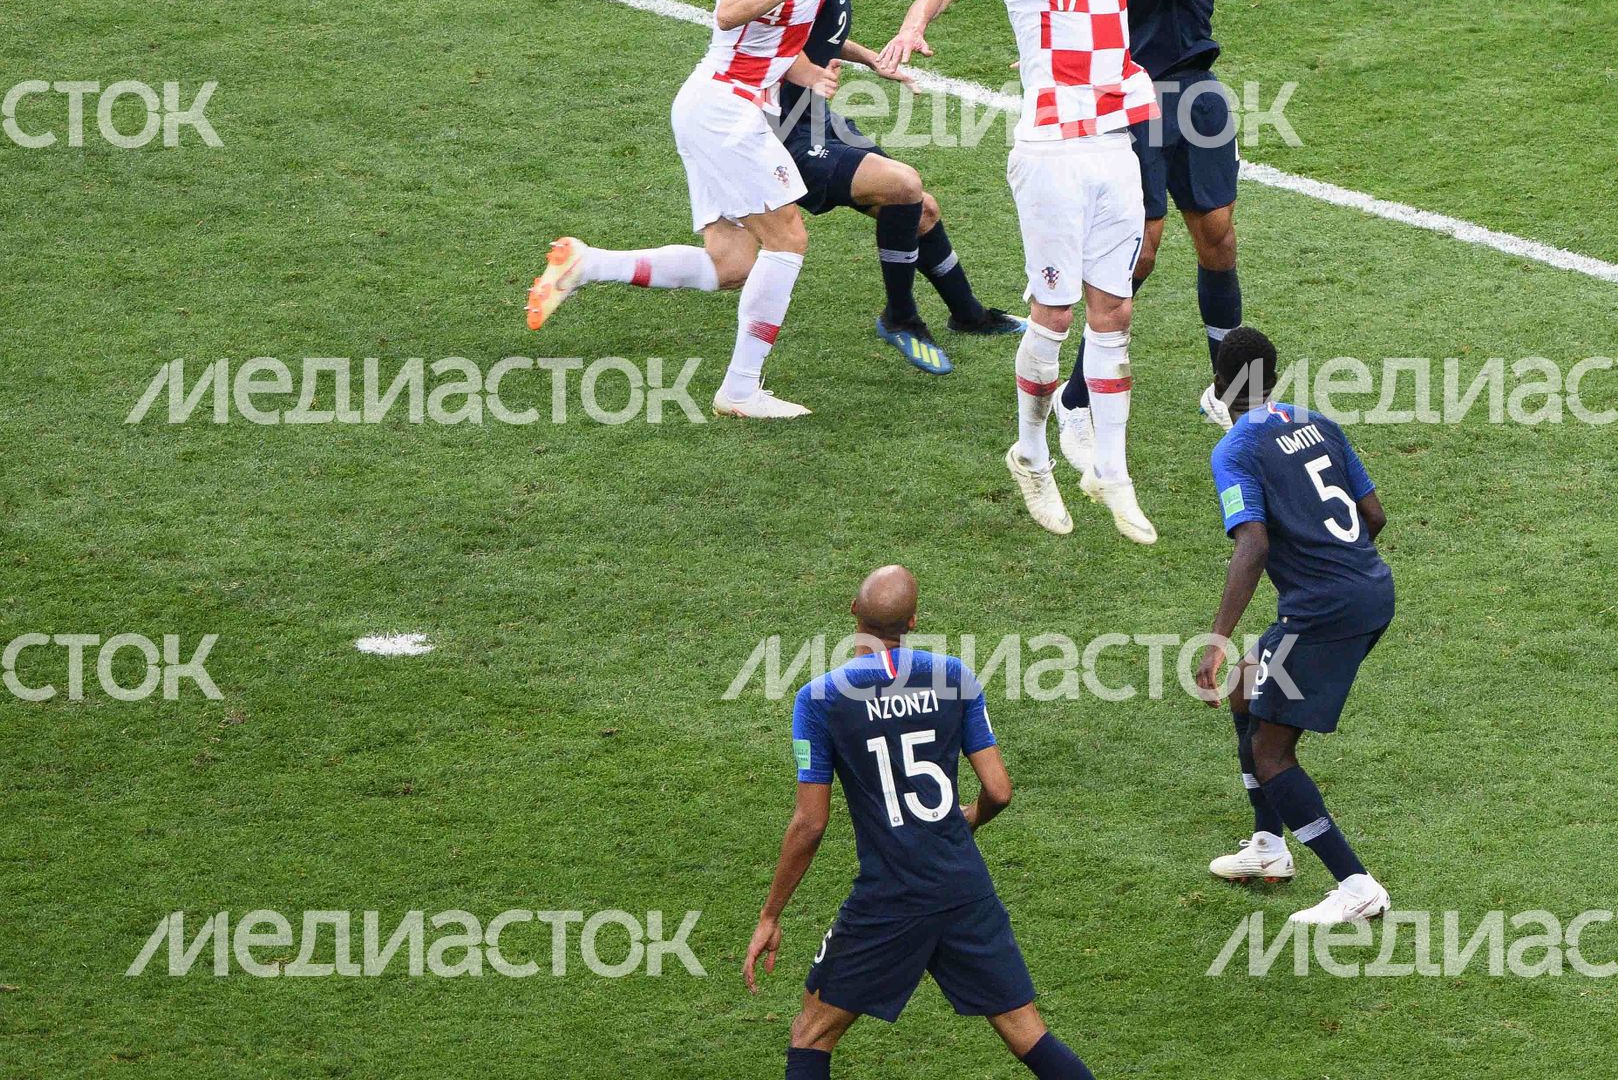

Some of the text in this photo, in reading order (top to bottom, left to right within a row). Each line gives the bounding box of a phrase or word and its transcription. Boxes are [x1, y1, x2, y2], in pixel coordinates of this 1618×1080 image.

[827, 11, 847, 44] 2
[1275, 424, 1325, 455] UMTITI
[1304, 454, 1360, 543] 5
[1255, 648, 1272, 686] 5
[865, 689, 939, 721] NZONZI
[866, 729, 953, 827] 15
